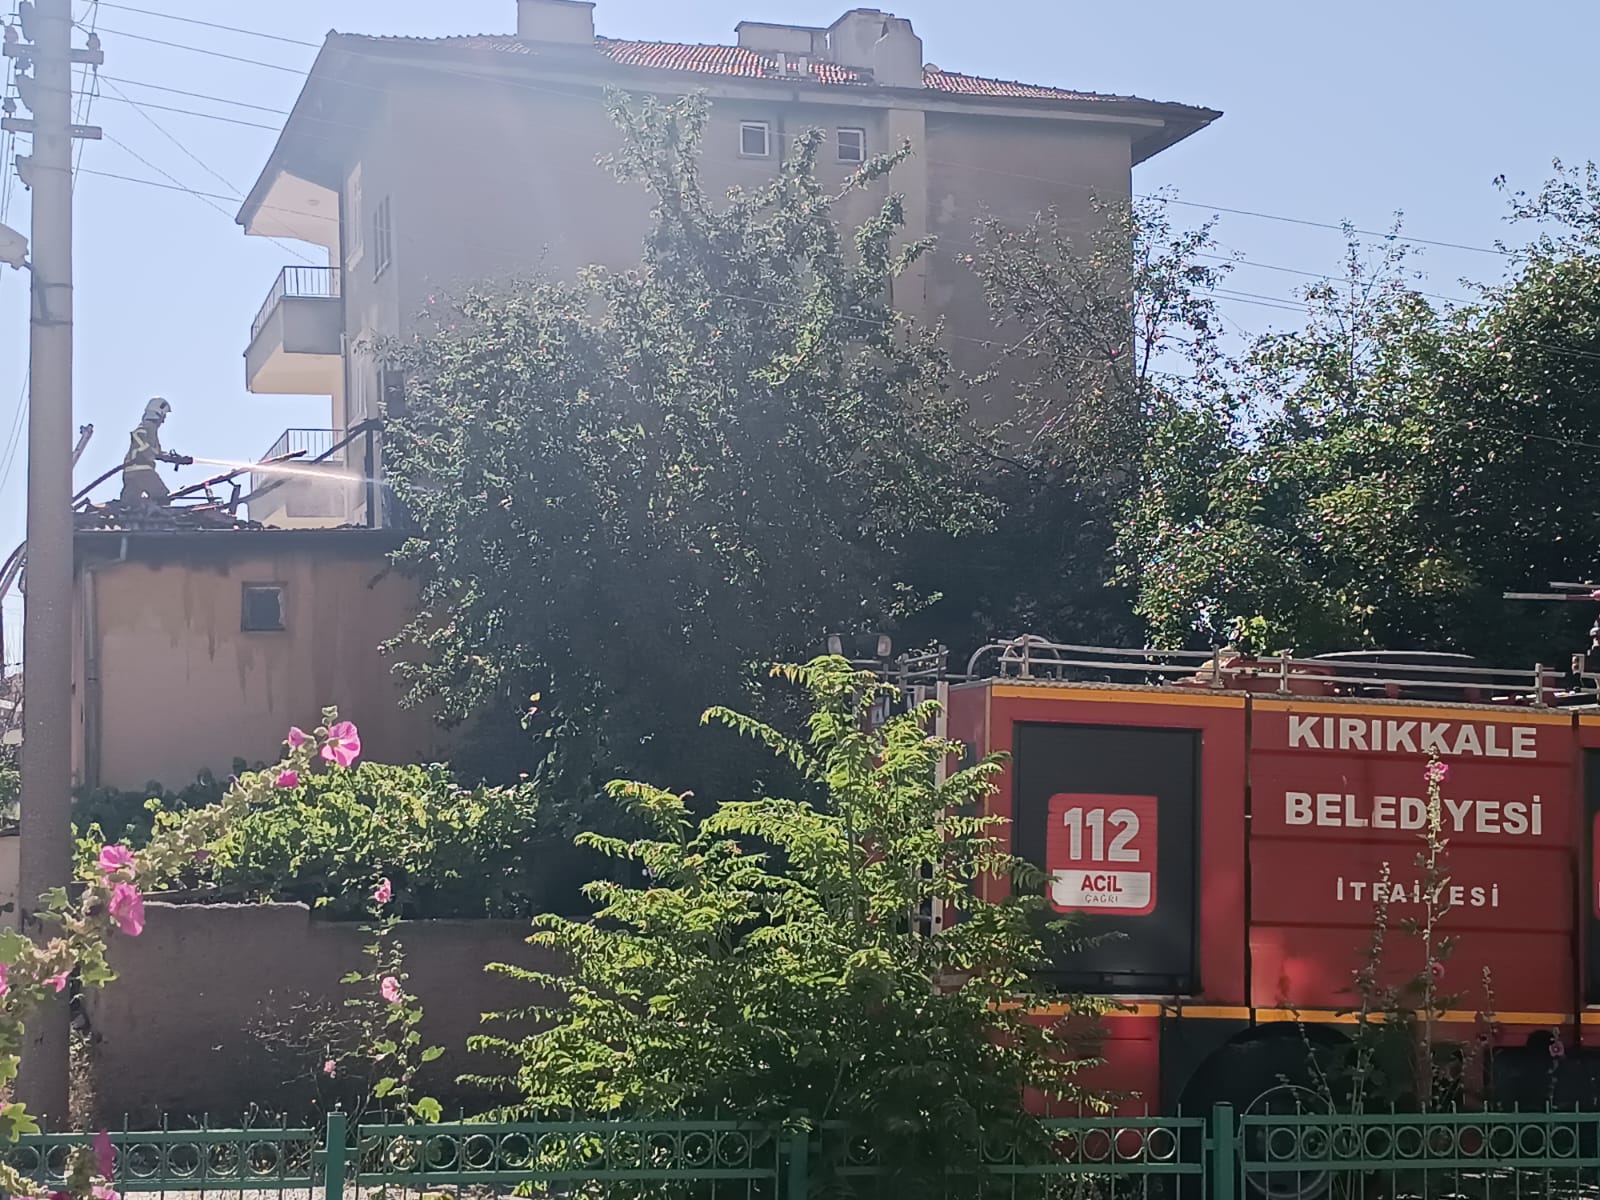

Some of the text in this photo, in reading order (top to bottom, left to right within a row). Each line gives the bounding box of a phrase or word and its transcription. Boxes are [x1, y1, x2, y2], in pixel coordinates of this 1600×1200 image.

[1288, 715, 1537, 758] KIRIKKALE
[1063, 807, 1140, 862] 112
[1285, 791, 1542, 836] BELEDYESİ
